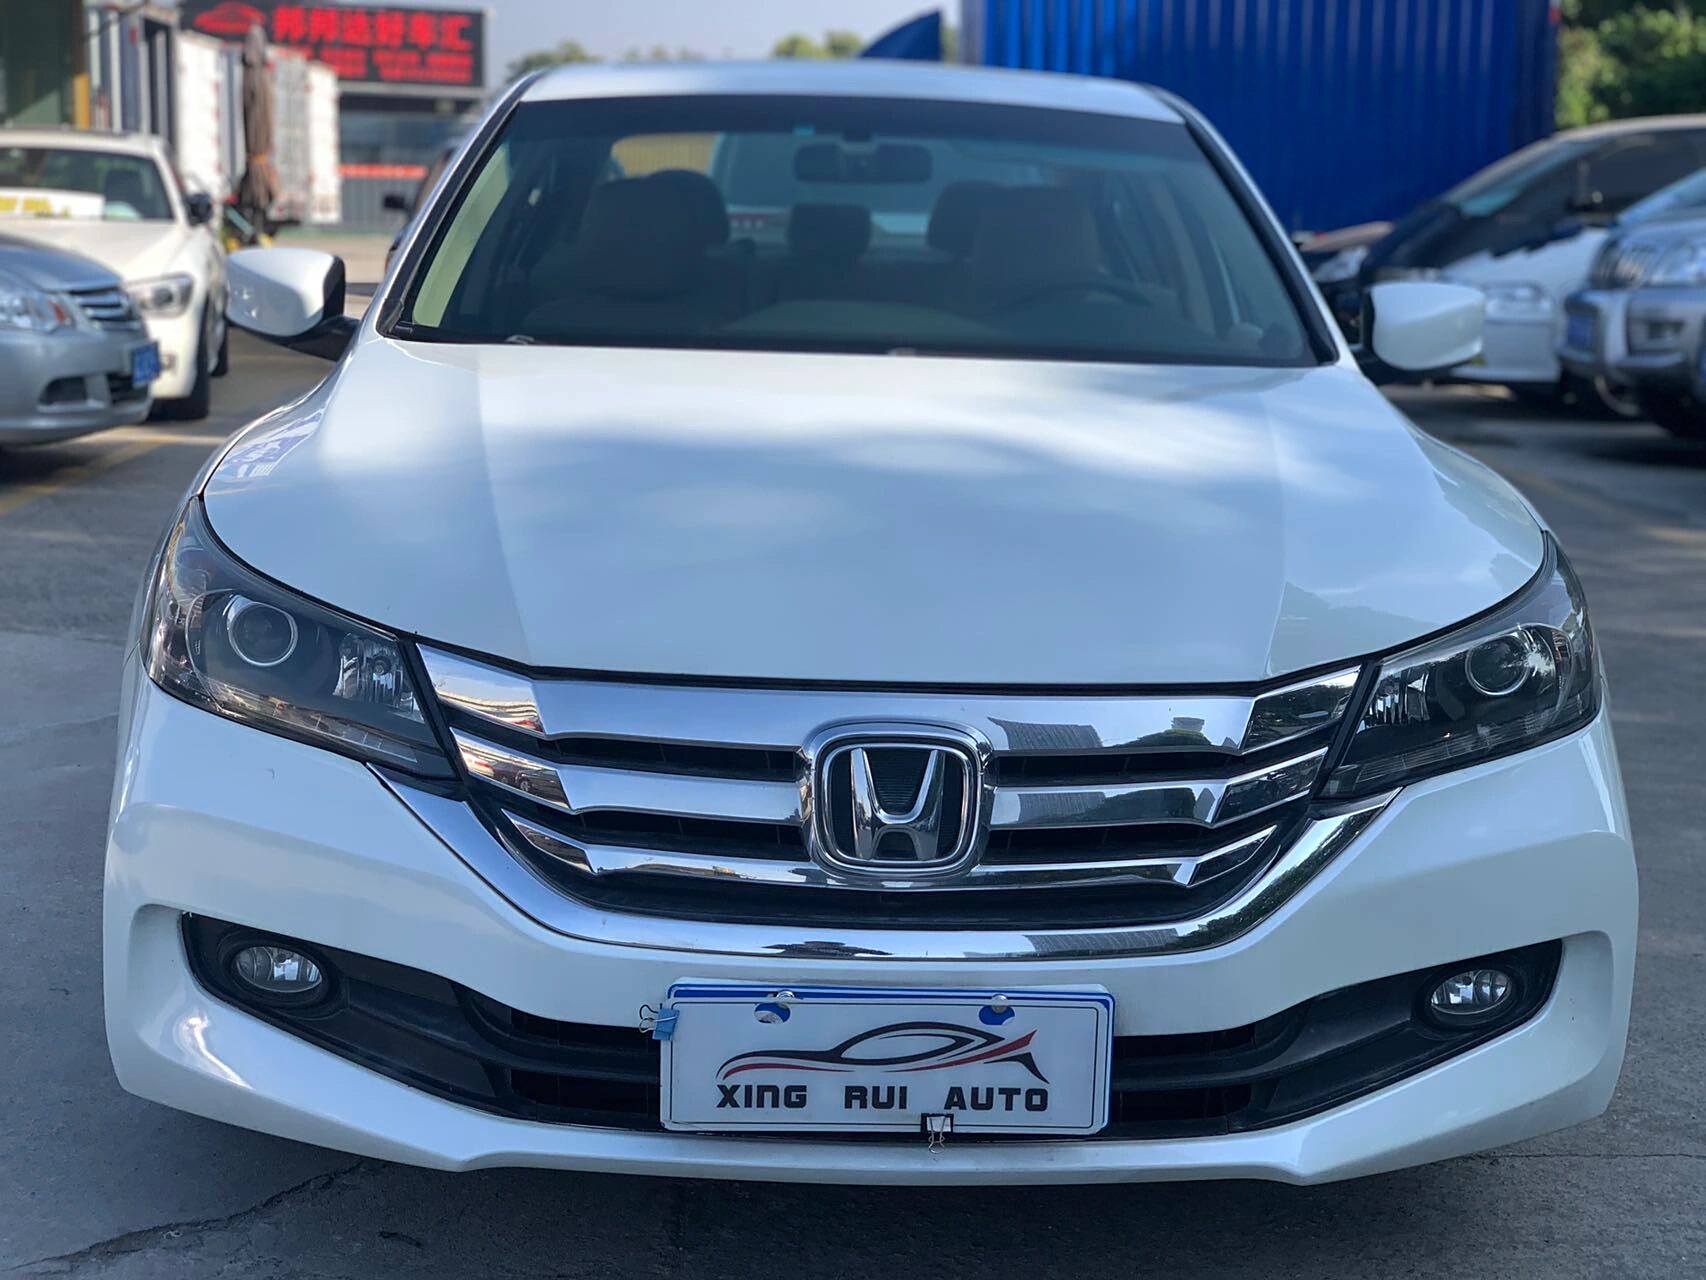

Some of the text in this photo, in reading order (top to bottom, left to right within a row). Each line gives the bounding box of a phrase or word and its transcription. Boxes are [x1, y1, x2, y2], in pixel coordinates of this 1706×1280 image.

[716, 1084, 1049, 1112] XING RUI AUTO
